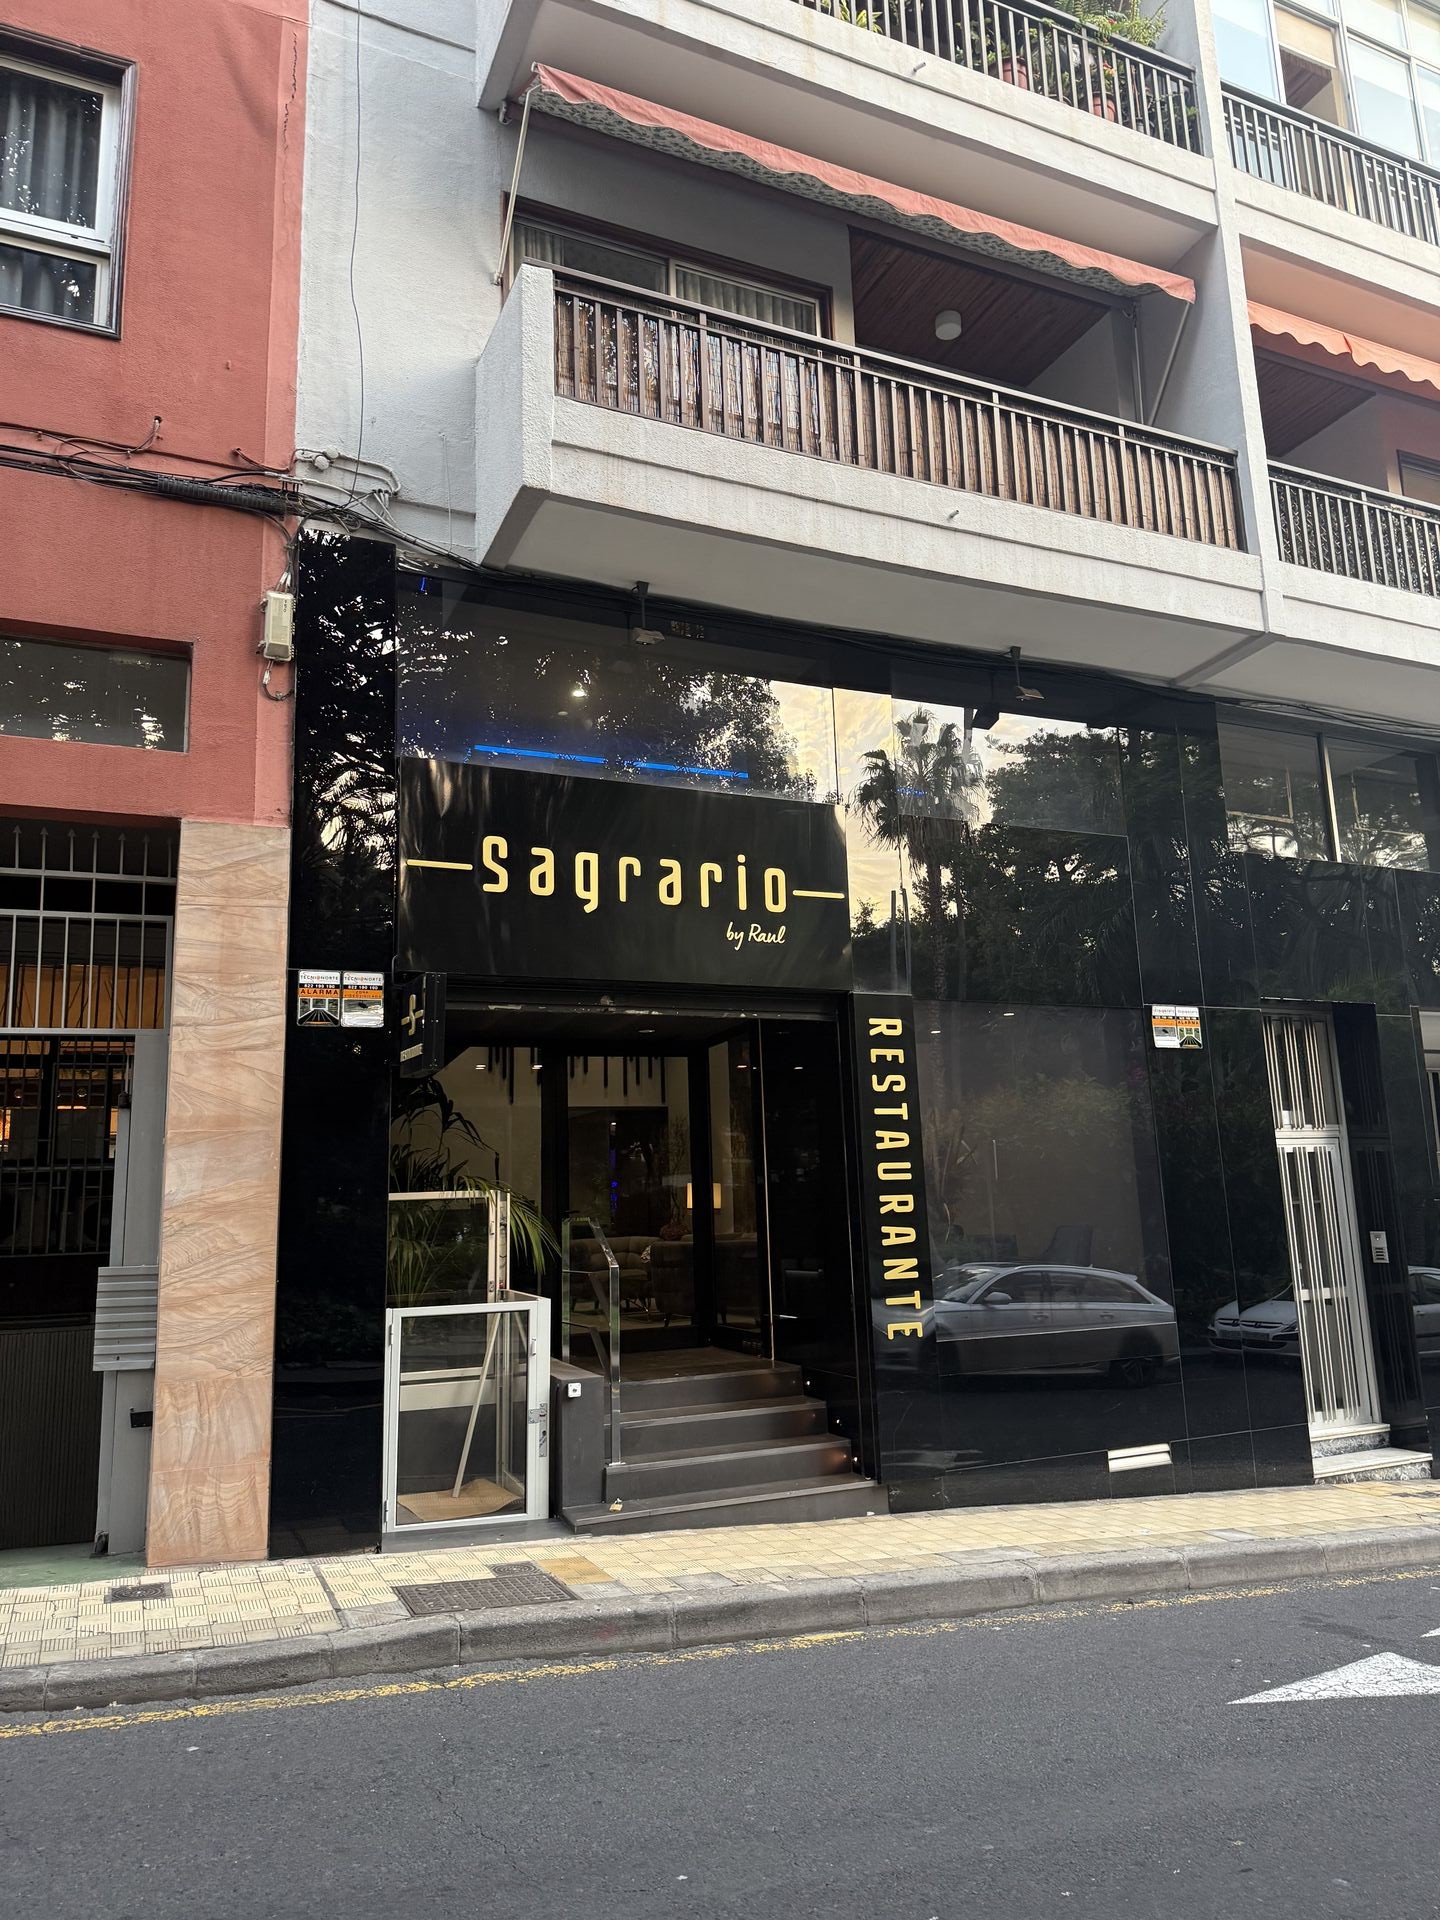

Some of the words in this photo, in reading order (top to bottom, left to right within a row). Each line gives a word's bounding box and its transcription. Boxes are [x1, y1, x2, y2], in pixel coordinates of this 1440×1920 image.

[482, 835, 787, 914] Sagrario
[726, 921, 745, 951] by
[748, 923, 786, 944] Raul
[300, 988, 339, 996] ALARMA
[868, 1017, 924, 1340] RESTAURANTE
